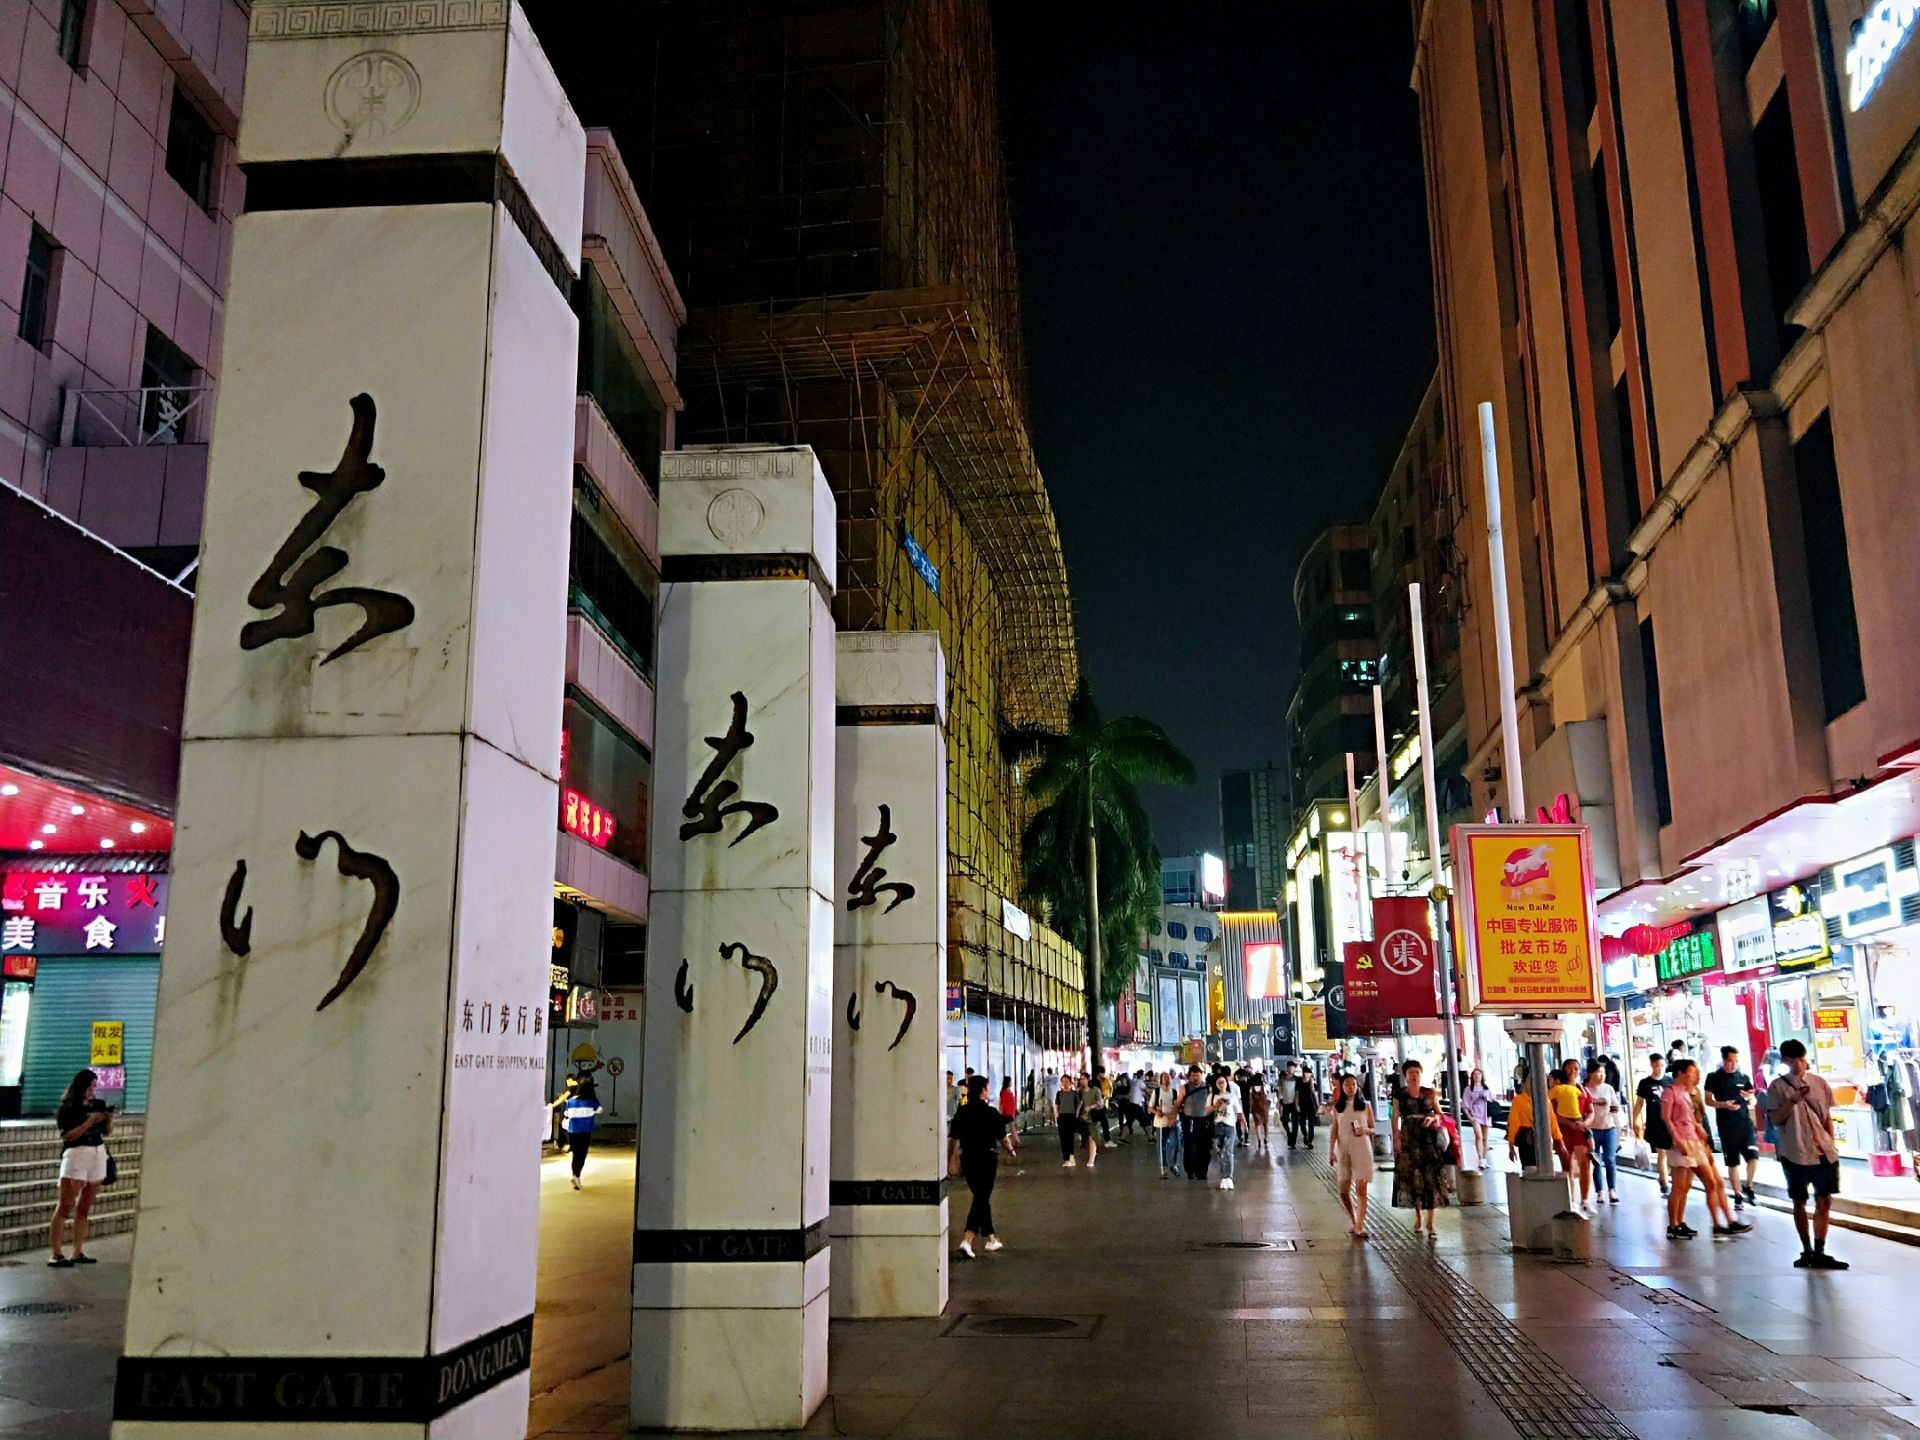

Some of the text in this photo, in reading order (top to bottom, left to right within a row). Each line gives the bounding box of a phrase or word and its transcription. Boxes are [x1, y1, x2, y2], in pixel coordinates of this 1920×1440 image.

[1507, 903, 1555, 911] New BaiMa
[1486, 918, 1578, 934] 中国专业服饰
[1501, 939, 1568, 955] 批发市场
[1513, 960, 1559, 974] 欢迎您
[94, 1026, 121, 1038] 假发
[455, 1054, 473, 1069] EAST
[475, 1055, 494, 1069] GATE
[438, 1328, 527, 1403] DONGMEN
[275, 1372, 404, 1409] GATE
